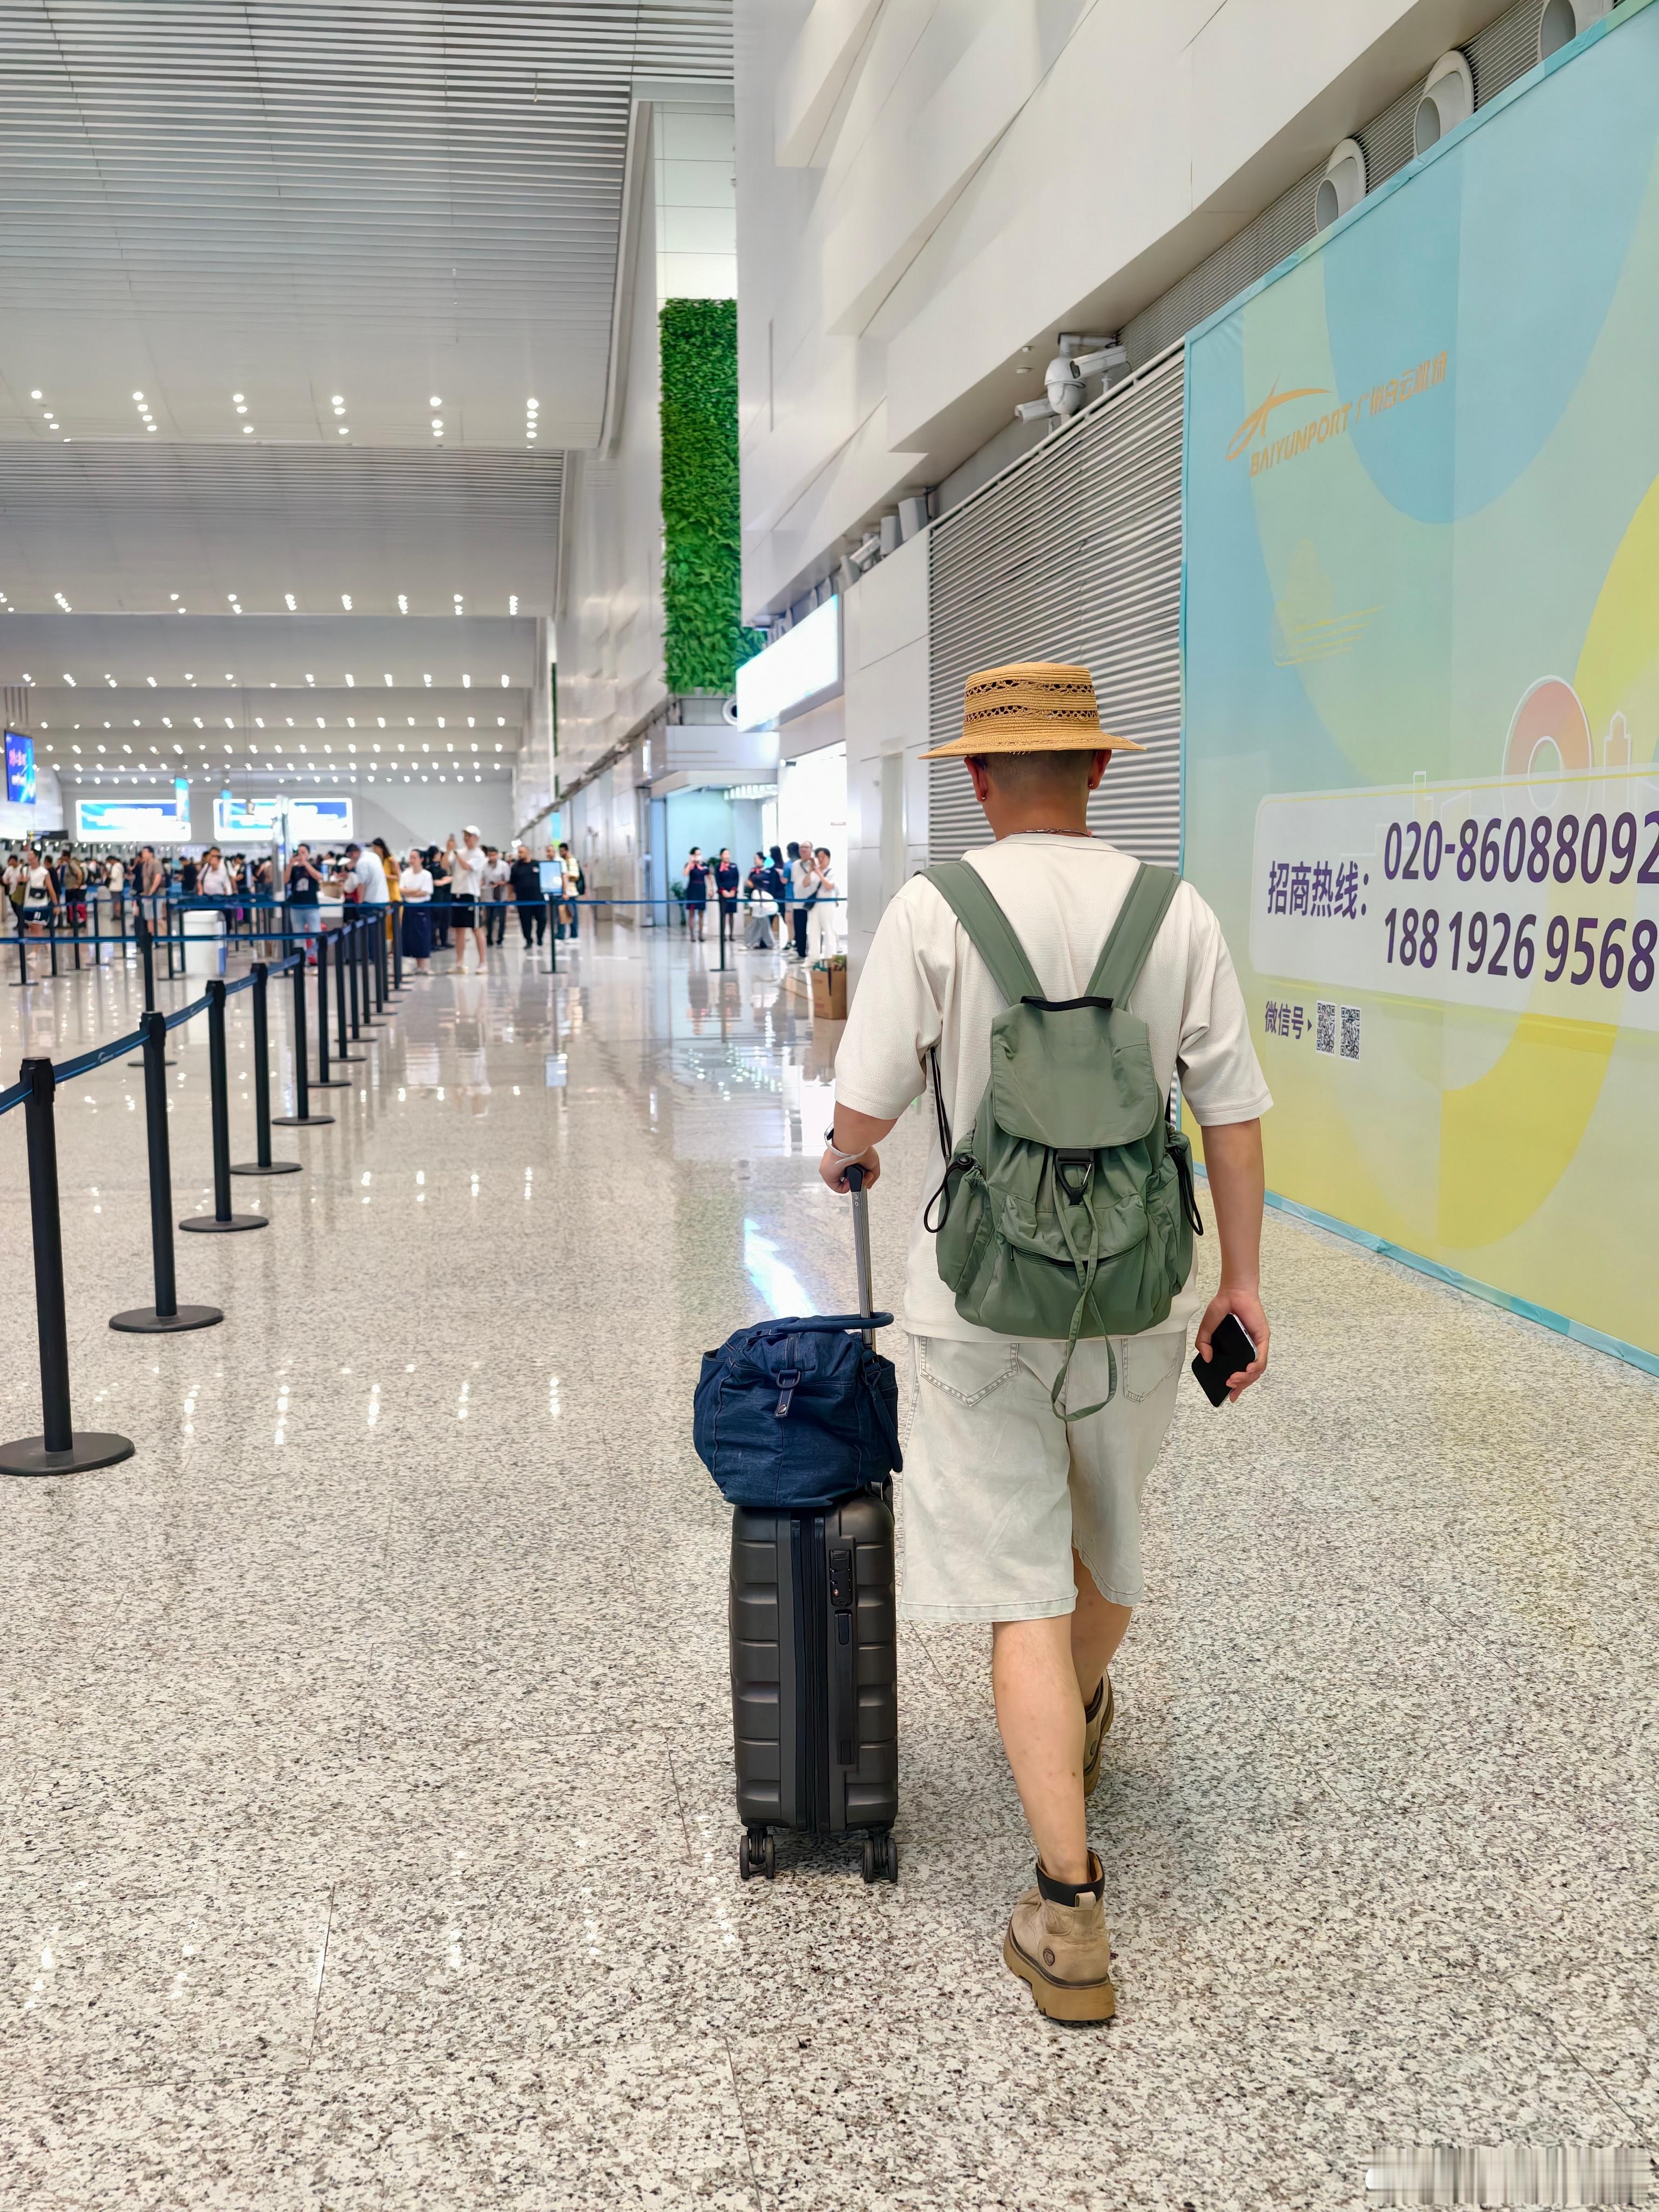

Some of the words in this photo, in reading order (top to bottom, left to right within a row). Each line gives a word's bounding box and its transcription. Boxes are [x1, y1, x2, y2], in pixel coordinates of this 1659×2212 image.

[1250, 402, 1352, 477] BAIYUNPORT
[1384, 811, 1659, 884] 020-86088092
[1267, 860, 1369, 920] 招商热线：
[1385, 908, 1439, 968] 188
[1449, 911, 1537, 979] 1926
[1545, 915, 1658, 992] 9568
[1265, 1001, 1304, 1040] 微信号
